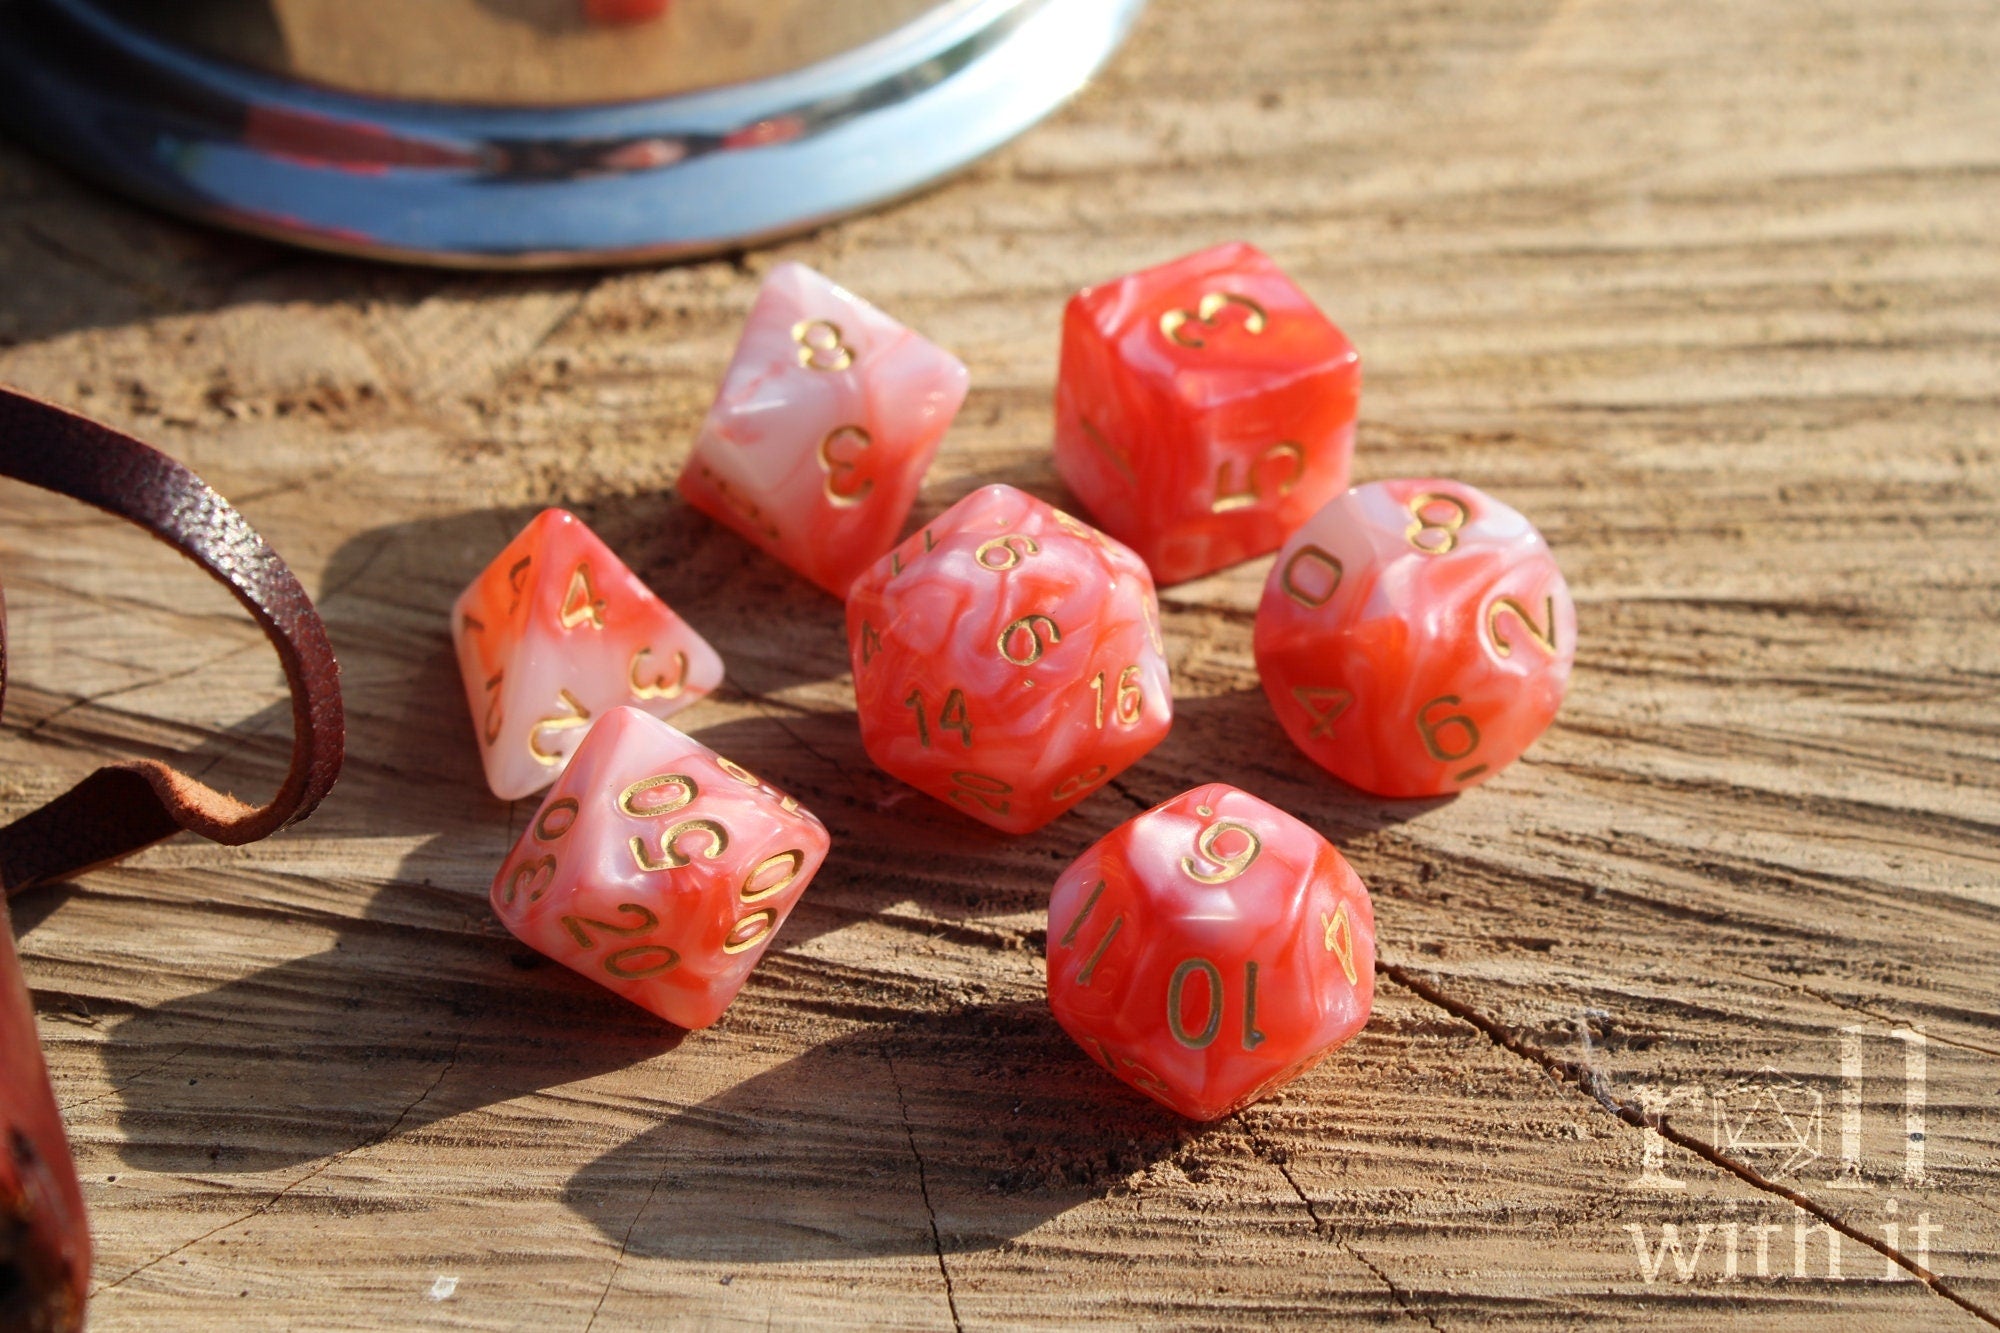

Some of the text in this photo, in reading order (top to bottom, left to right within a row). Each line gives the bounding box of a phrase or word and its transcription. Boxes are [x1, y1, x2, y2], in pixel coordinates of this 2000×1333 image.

[1159, 291, 1268, 349] 3
[817, 424, 875, 508] 3
[1405, 492, 1471, 555] 8
[561, 562, 606, 630] 4
[629, 646, 690, 700] 3
[1090, 665, 1143, 729] 16
[905, 689, 974, 748] 14
[1166, 957, 1266, 1052] 10
